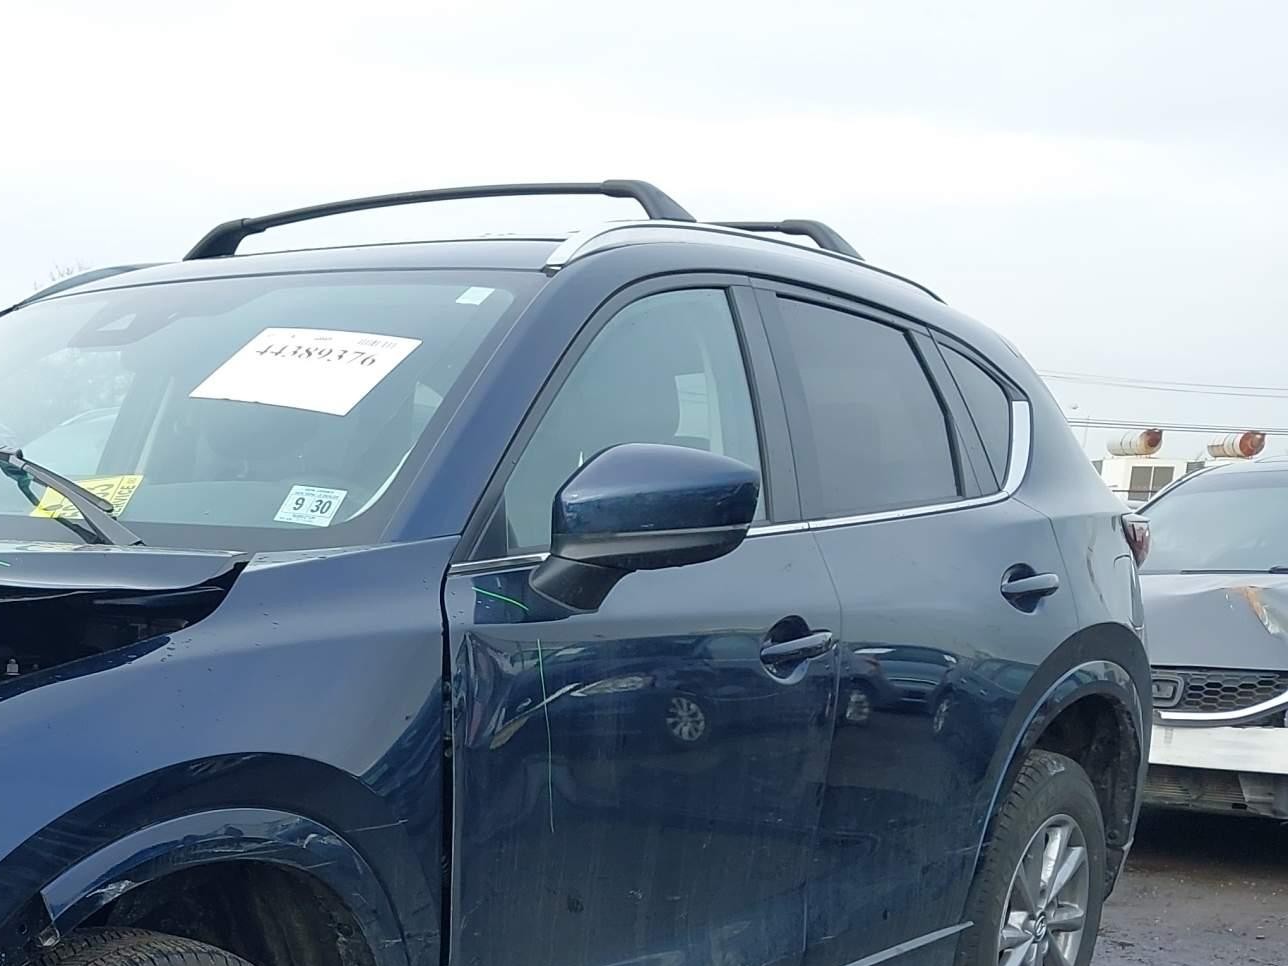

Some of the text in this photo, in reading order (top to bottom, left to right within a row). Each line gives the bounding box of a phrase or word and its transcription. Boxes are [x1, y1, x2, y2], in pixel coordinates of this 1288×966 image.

[256, 344, 377, 367] 44389376
[293, 497, 332, 515] 9 30
